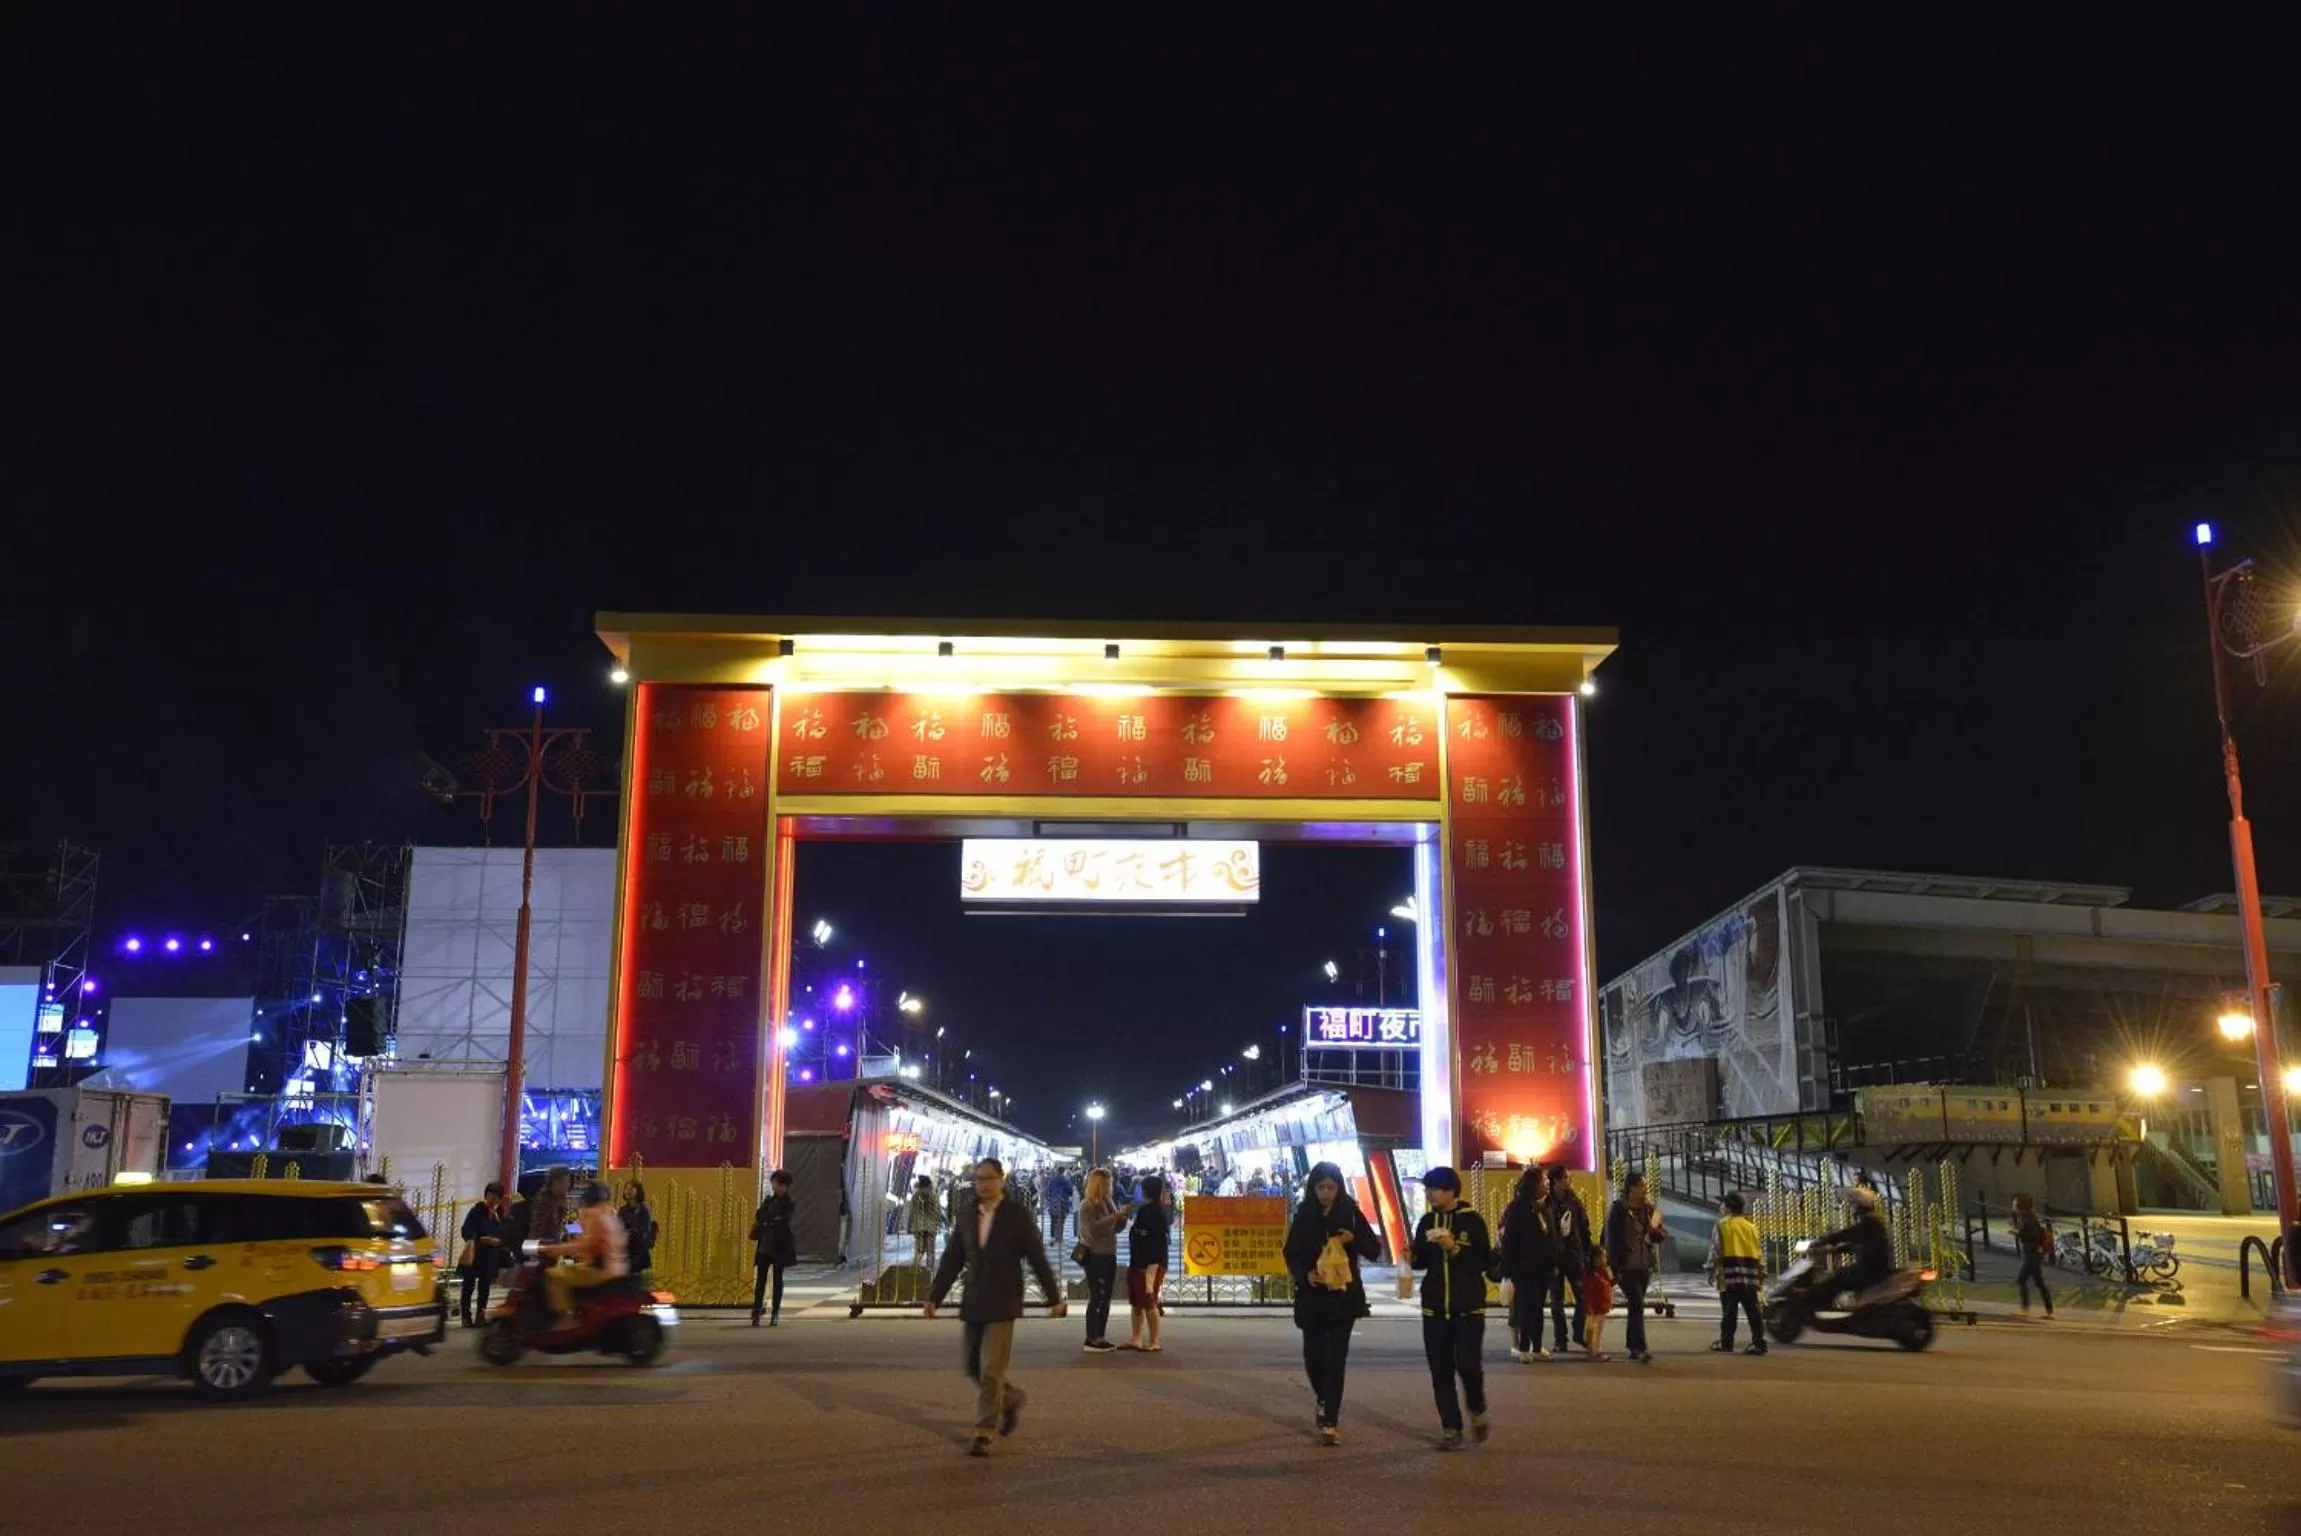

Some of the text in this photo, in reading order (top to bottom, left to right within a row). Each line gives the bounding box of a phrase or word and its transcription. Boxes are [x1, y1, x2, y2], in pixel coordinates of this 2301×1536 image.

[792, 709, 1424, 748] 福 福 福 福 福 福 福 福 福 福
[790, 751, 1424, 787] 福 福 福 福 福 福 福 福 福 福
